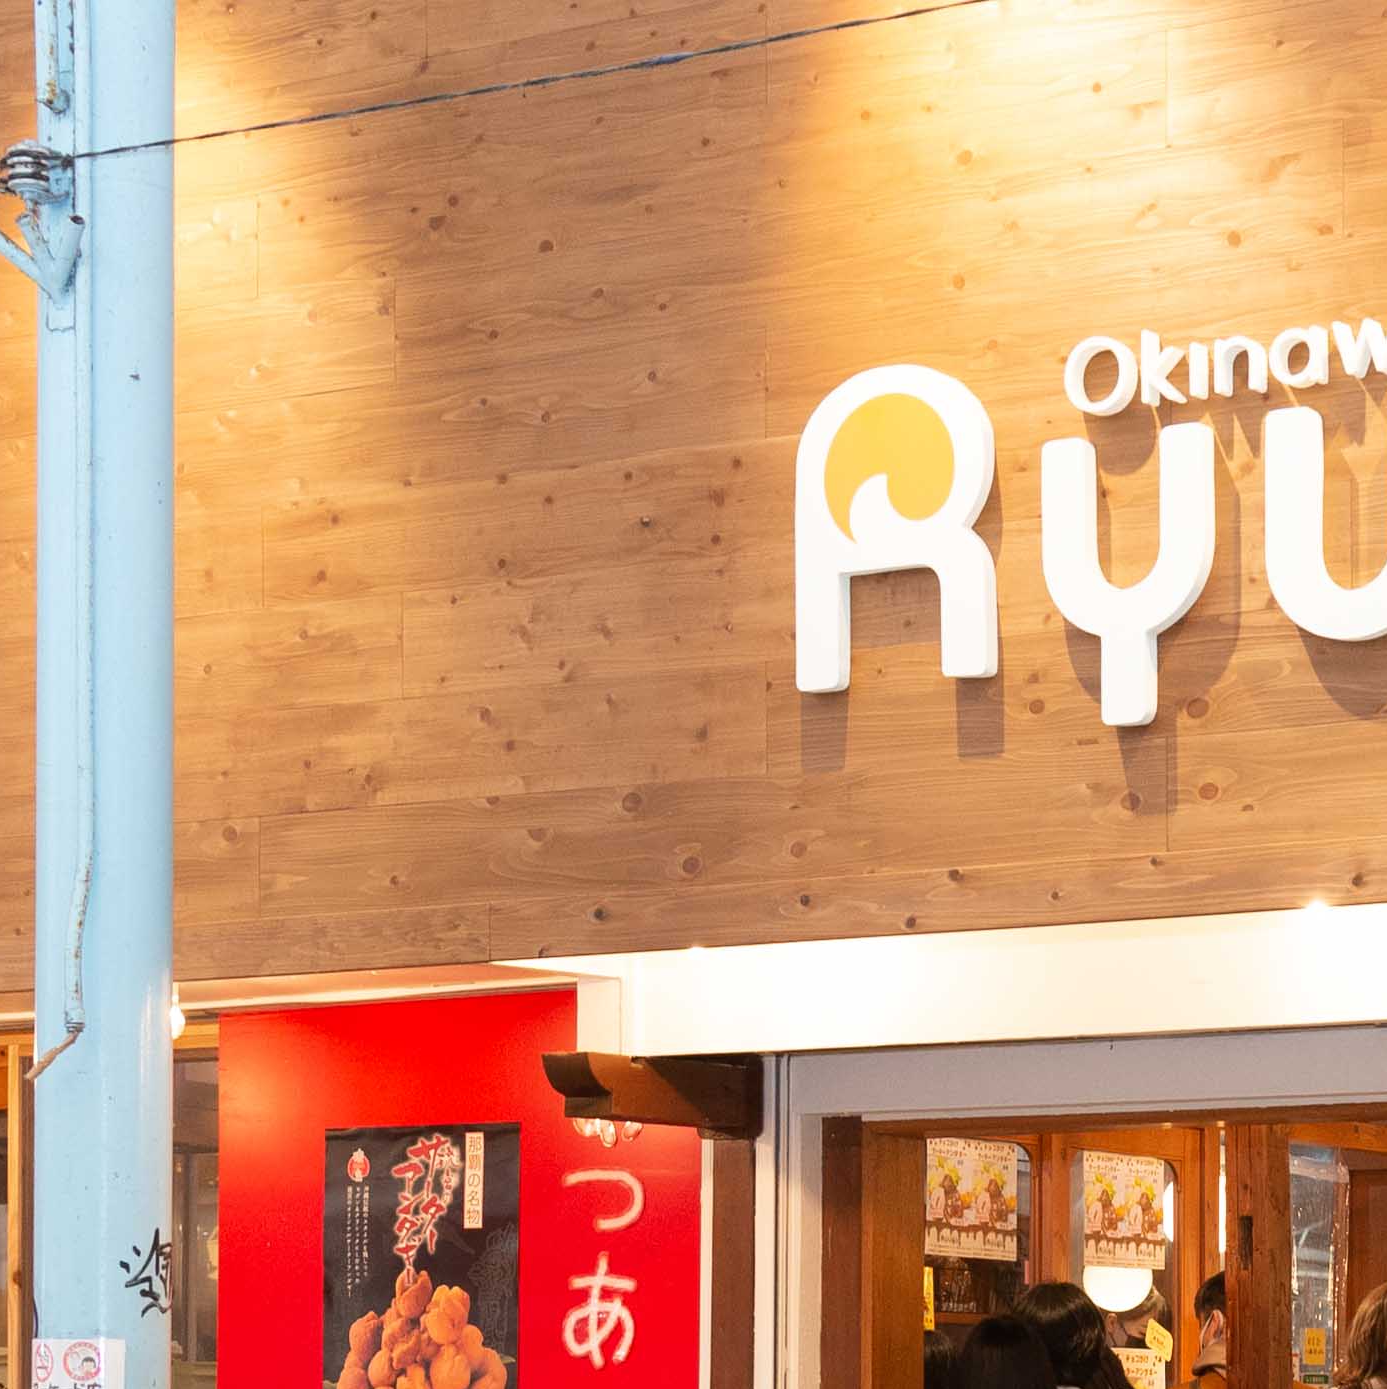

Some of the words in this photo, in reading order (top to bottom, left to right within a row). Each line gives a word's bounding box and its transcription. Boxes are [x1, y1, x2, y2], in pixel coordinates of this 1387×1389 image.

[466, 1134, 483, 1226] 那覇の名物
